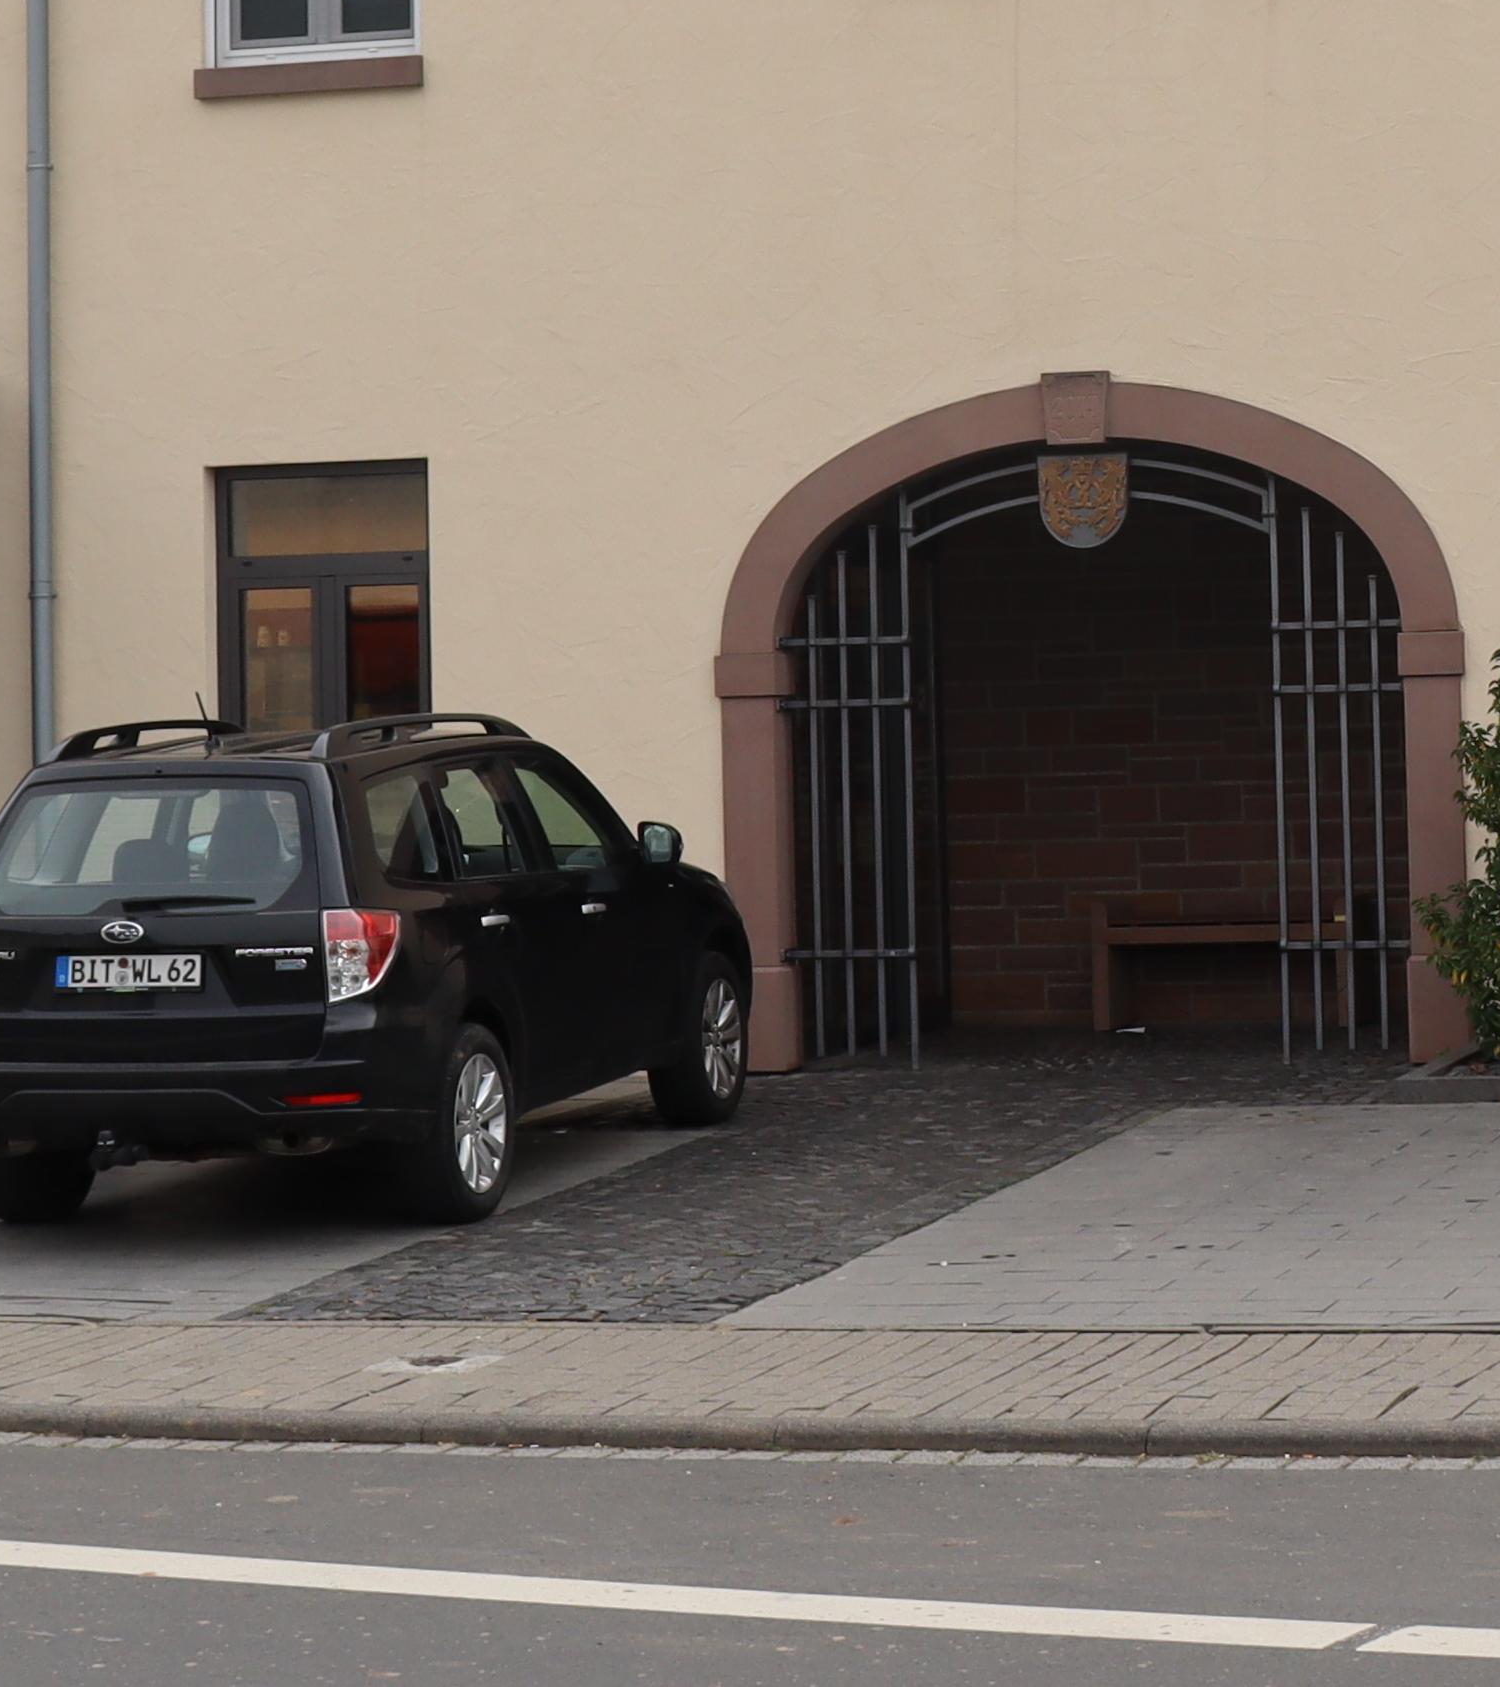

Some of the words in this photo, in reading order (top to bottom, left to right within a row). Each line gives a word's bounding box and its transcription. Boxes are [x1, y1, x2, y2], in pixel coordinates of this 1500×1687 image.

[71, 959, 115, 984] BIT
[132, 958, 161, 983] WL
[167, 958, 196, 983] 62
